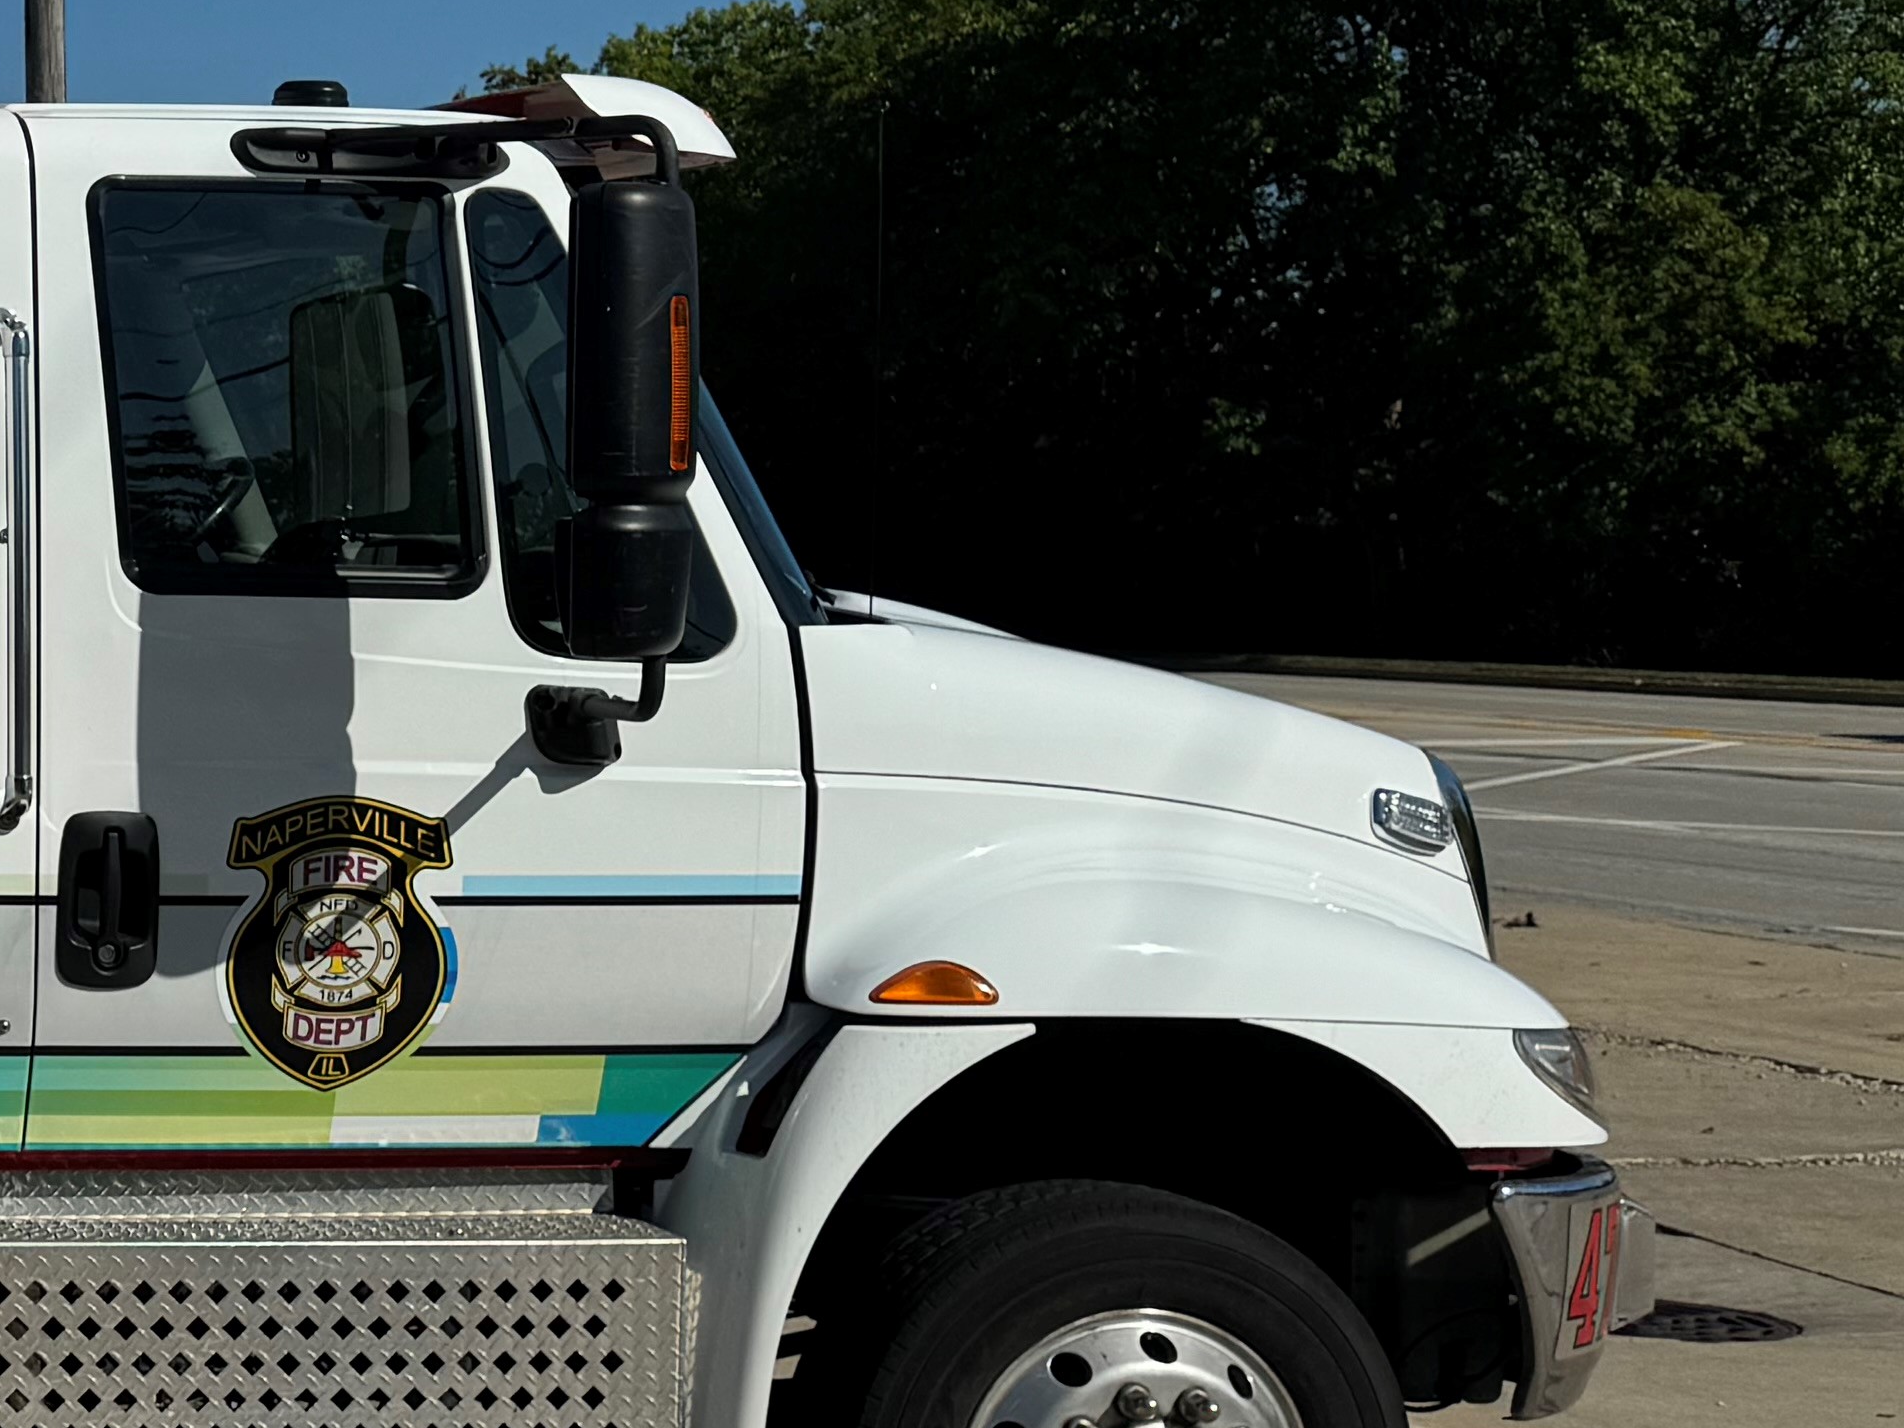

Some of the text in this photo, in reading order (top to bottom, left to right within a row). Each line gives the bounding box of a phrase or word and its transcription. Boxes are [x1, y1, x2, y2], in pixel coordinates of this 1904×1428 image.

[242, 805, 435, 859] NAPERVILLE
[303, 855, 378, 886] FIRE
[320, 898, 358, 912] NFD
[282, 941, 394, 962] F D
[319, 988, 353, 1002] 1874
[292, 1013, 376, 1045] DEPT
[321, 1058, 341, 1075] IL
